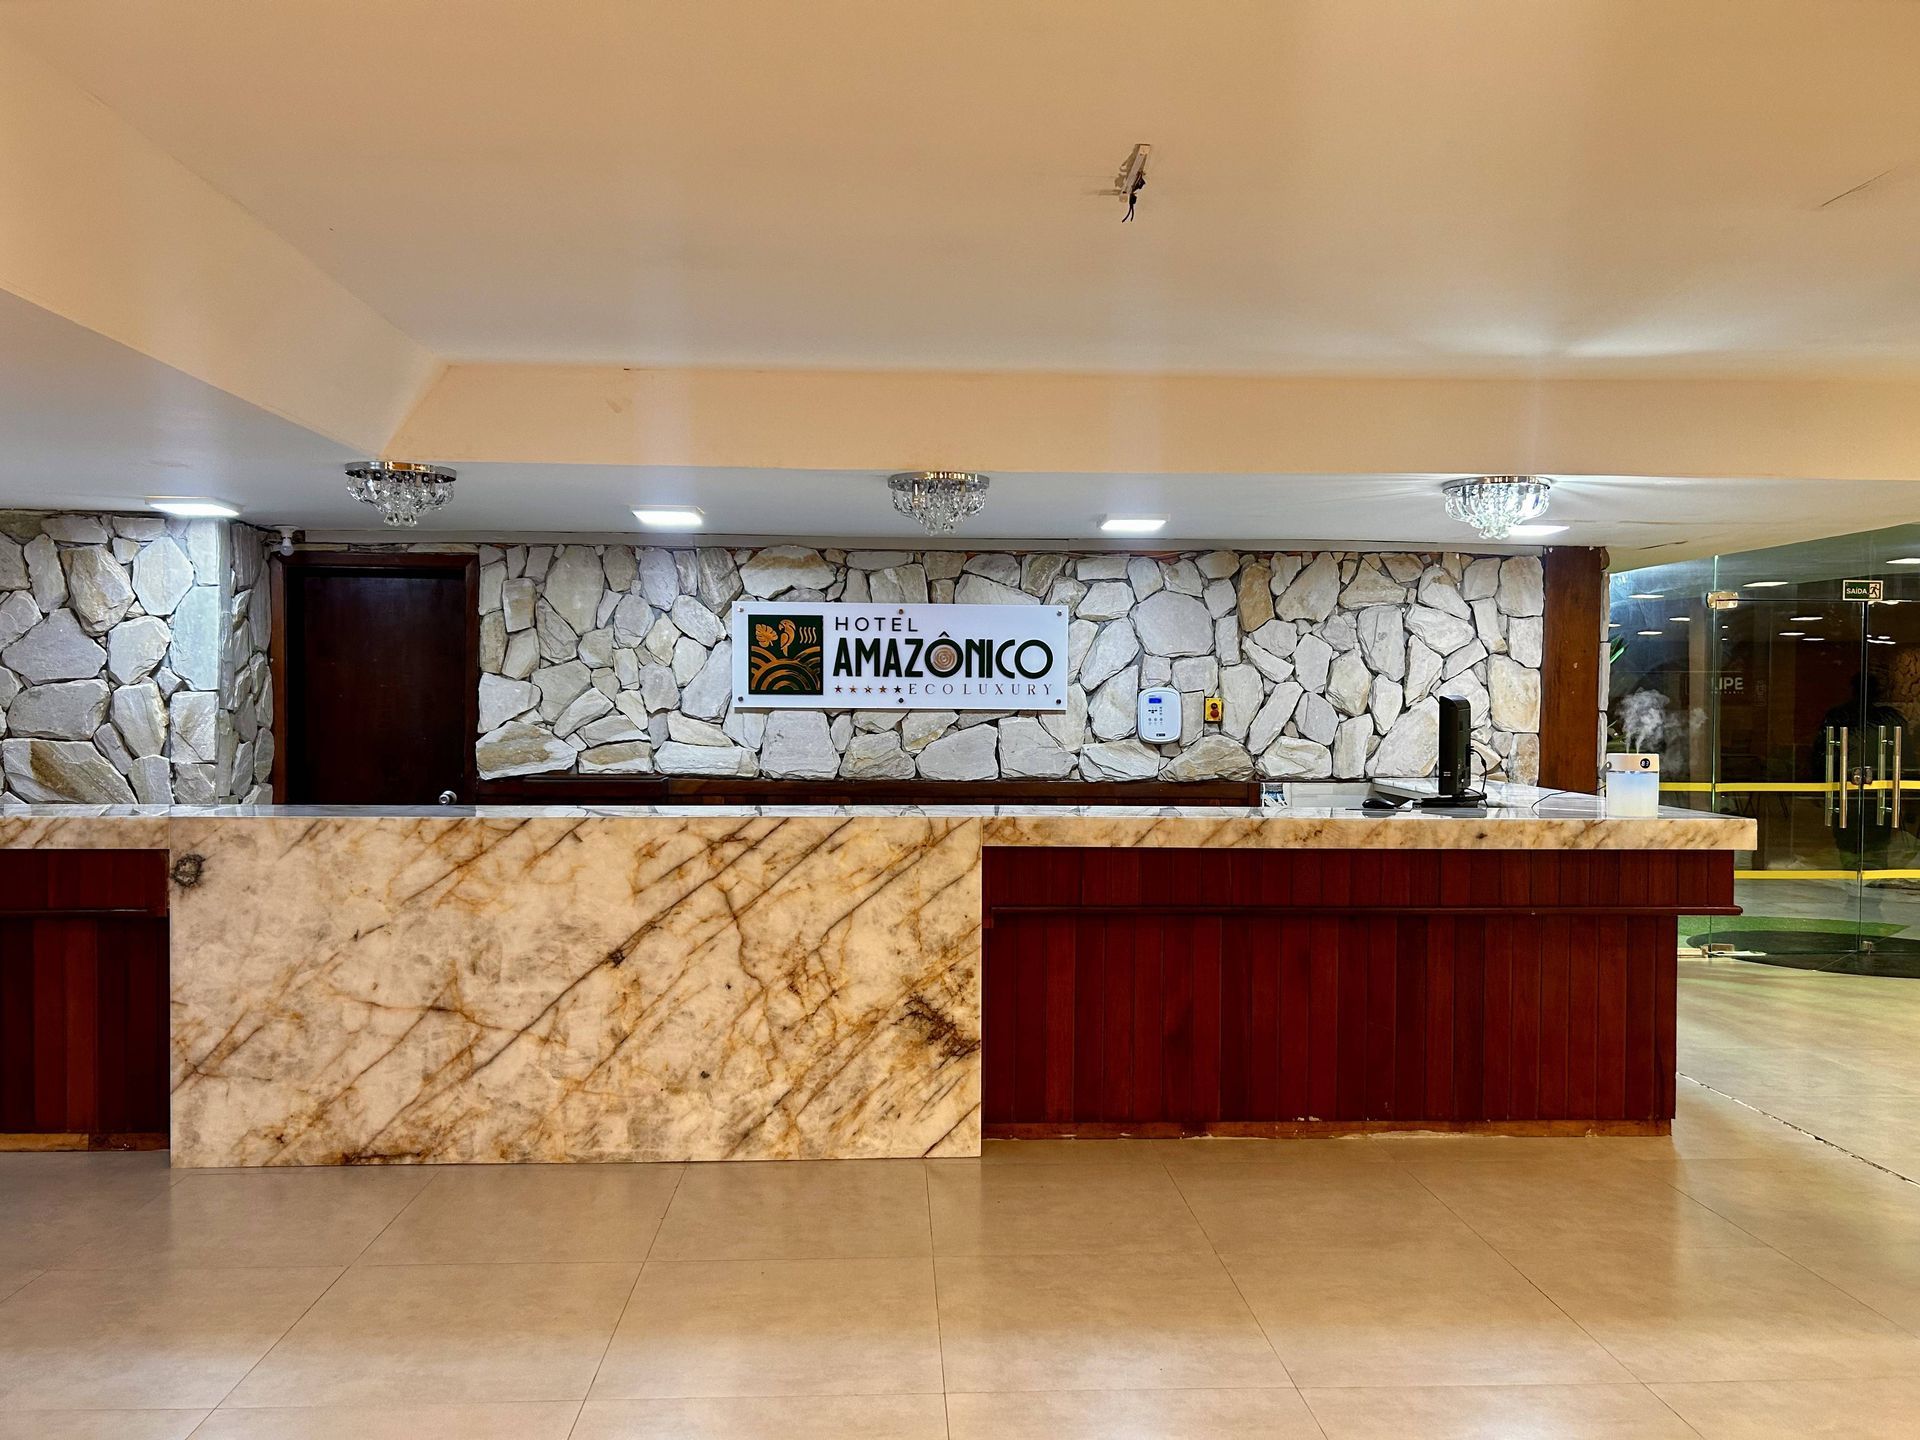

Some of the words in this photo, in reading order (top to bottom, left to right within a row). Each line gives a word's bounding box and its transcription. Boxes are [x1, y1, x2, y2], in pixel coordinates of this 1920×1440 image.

[1846, 586, 1868, 595] SAÍDA
[835, 616, 919, 632] HOTEL
[833, 631, 1054, 680] AMAZÔNICO
[908, 682, 1053, 696] ECOLUXURY
